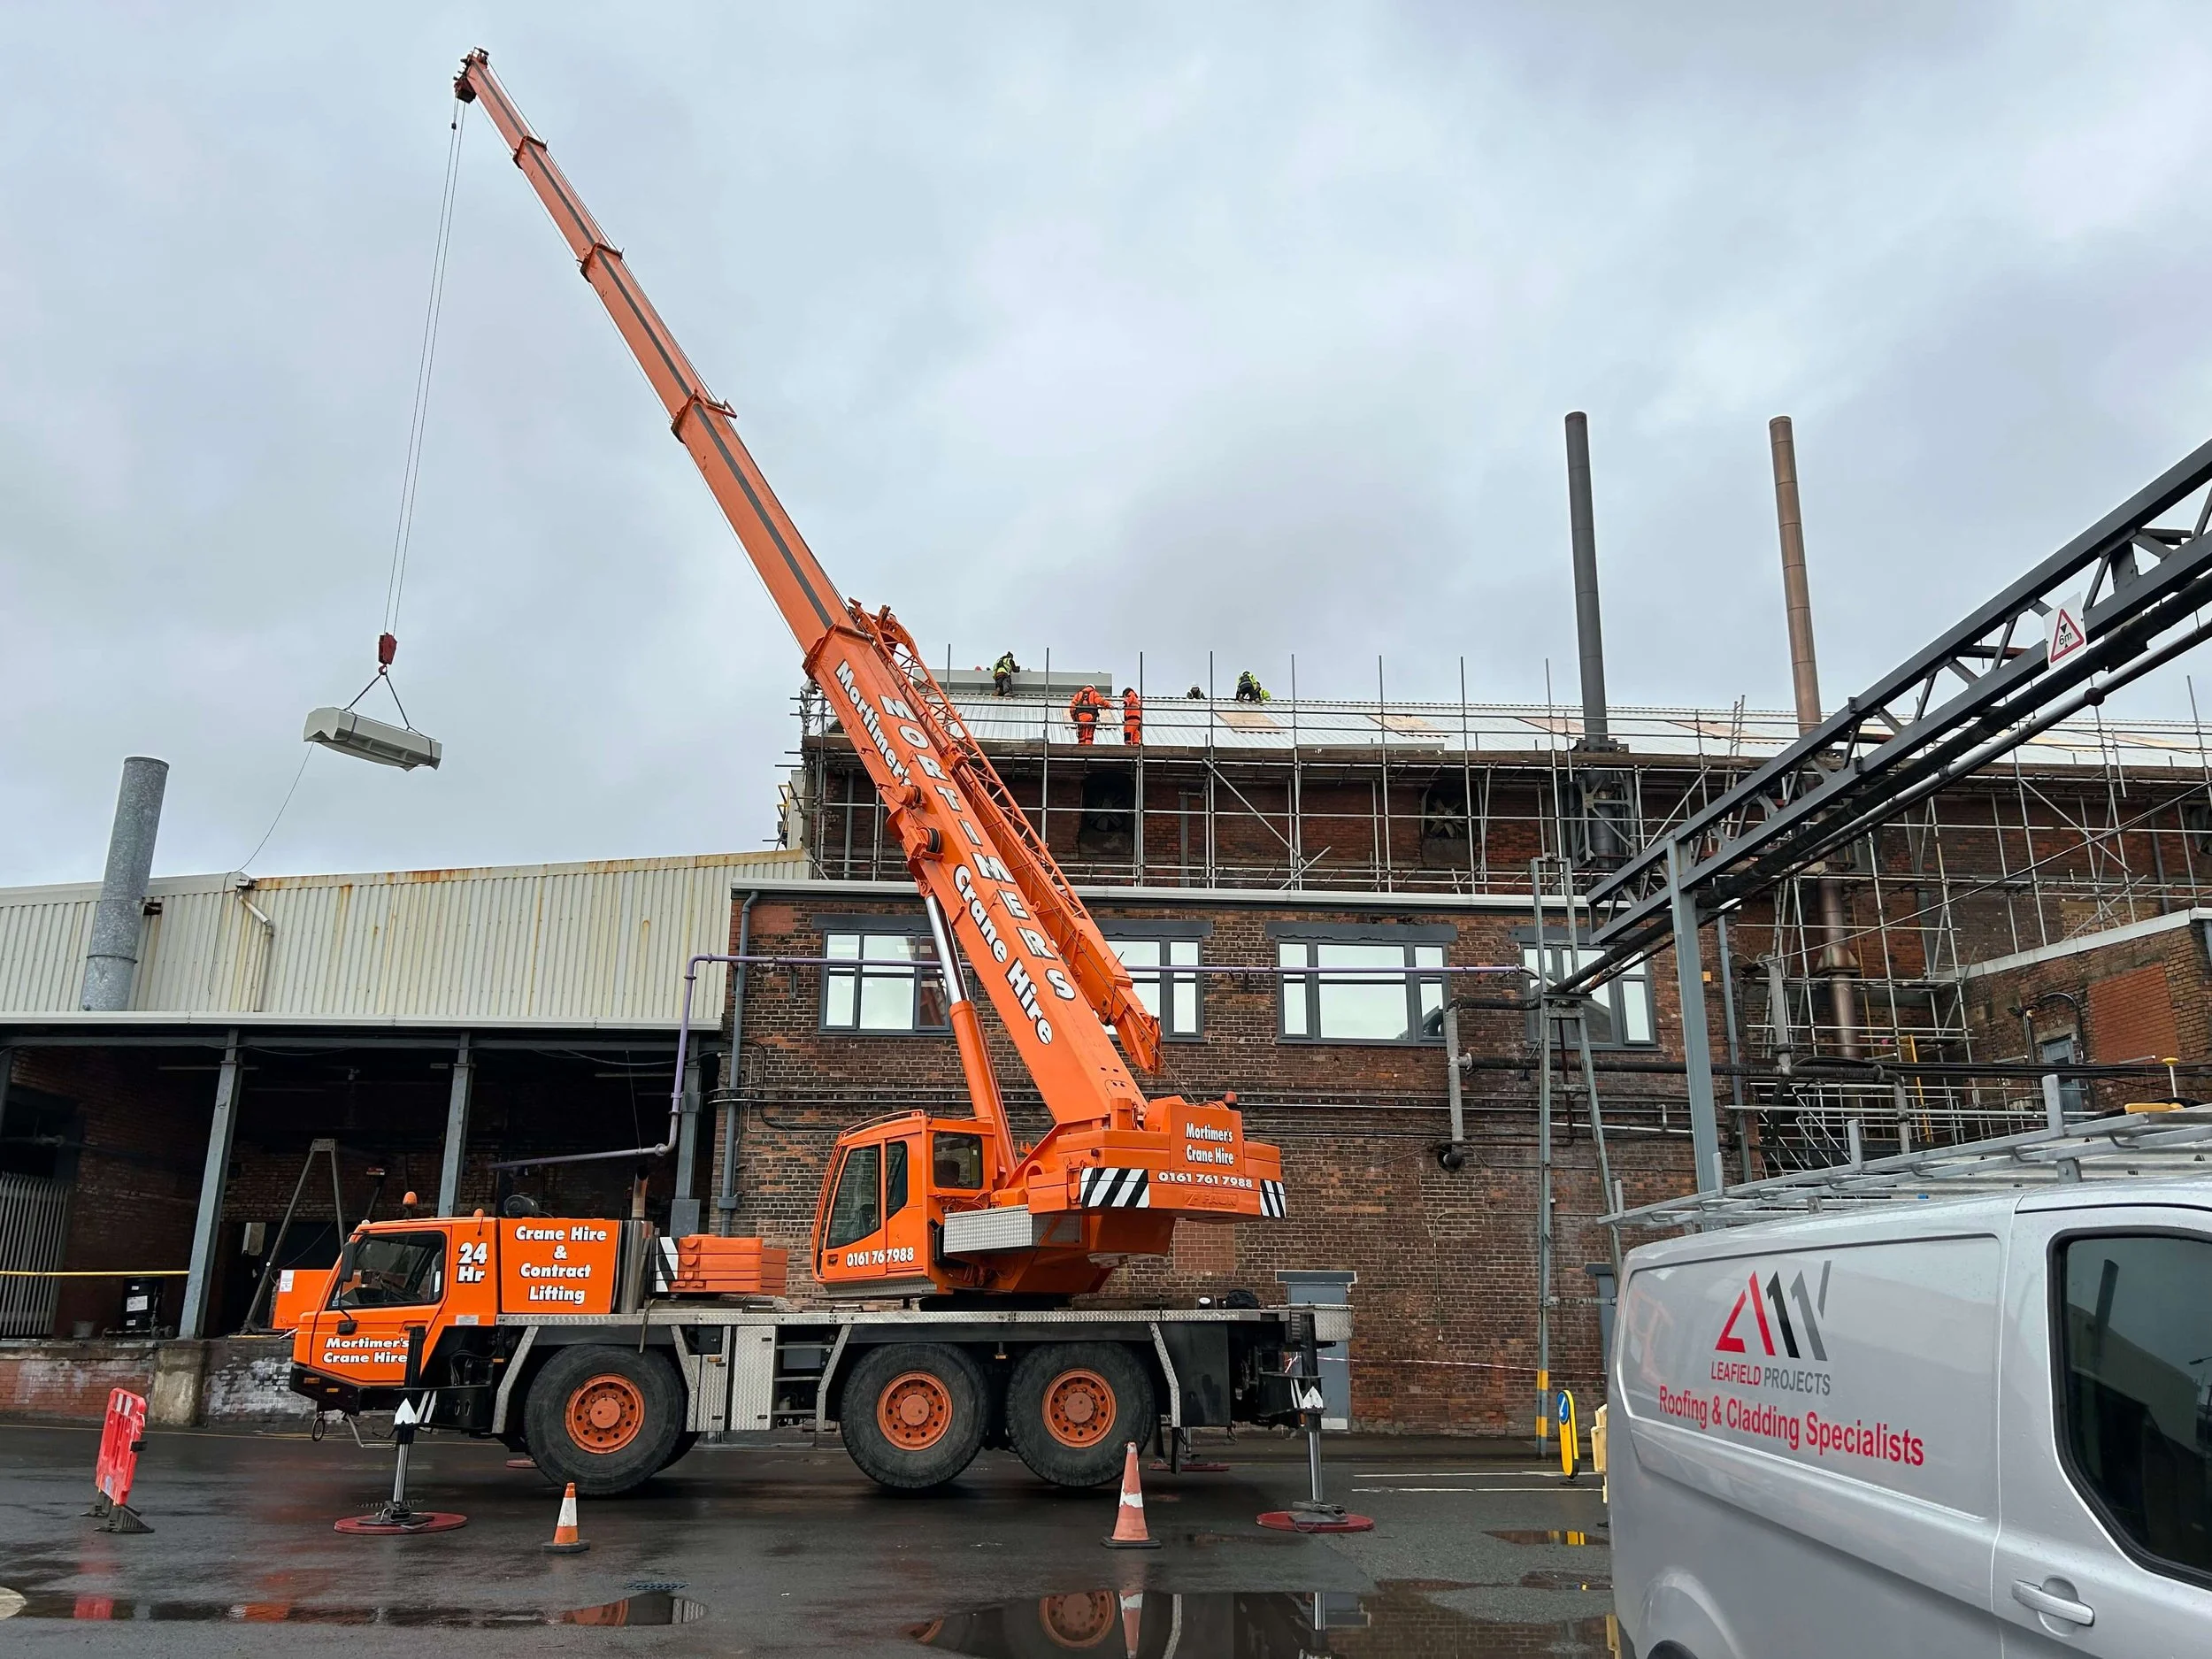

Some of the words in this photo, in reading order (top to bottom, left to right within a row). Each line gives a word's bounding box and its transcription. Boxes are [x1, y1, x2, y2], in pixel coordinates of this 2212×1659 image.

[2059, 632, 2072, 645] 6m
[879, 694, 1076, 1002] MORTIMERS
[953, 864, 1008, 964] Crane
[1005, 956, 1053, 1045] Hire
[1186, 1123, 1233, 1142] Mortimer's
[1186, 1144, 1213, 1163] Crane
[1215, 1147, 1234, 1165] Hire
[1158, 1171, 1193, 1183] 0161
[1195, 1173, 1218, 1185] 761
[1222, 1176, 1253, 1188] 7988
[515, 1225, 565, 1241] Crane
[570, 1226, 607, 1242] Hire
[457, 1241, 488, 1265] 24
[553, 1244, 568, 1260] &
[846, 1252, 869, 1267] 0161
[457, 1265, 485, 1283] Hr
[520, 1263, 592, 1279] Contract
[529, 1285, 586, 1305] Lifting
[325, 1337, 410, 1348] Mortimer's
[323, 1352, 370, 1363] Crane
[373, 1351, 408, 1363] Hire
[1710, 1361, 1762, 1386] LEAFIELD
[1763, 1367, 1832, 1396] PROJECTS
[1658, 1386, 1708, 1430] Roofing
[1711, 1394, 1722, 1425] &
[1726, 1398, 1800, 1450] Cladding
[1806, 1411, 1925, 1467] Specialists
